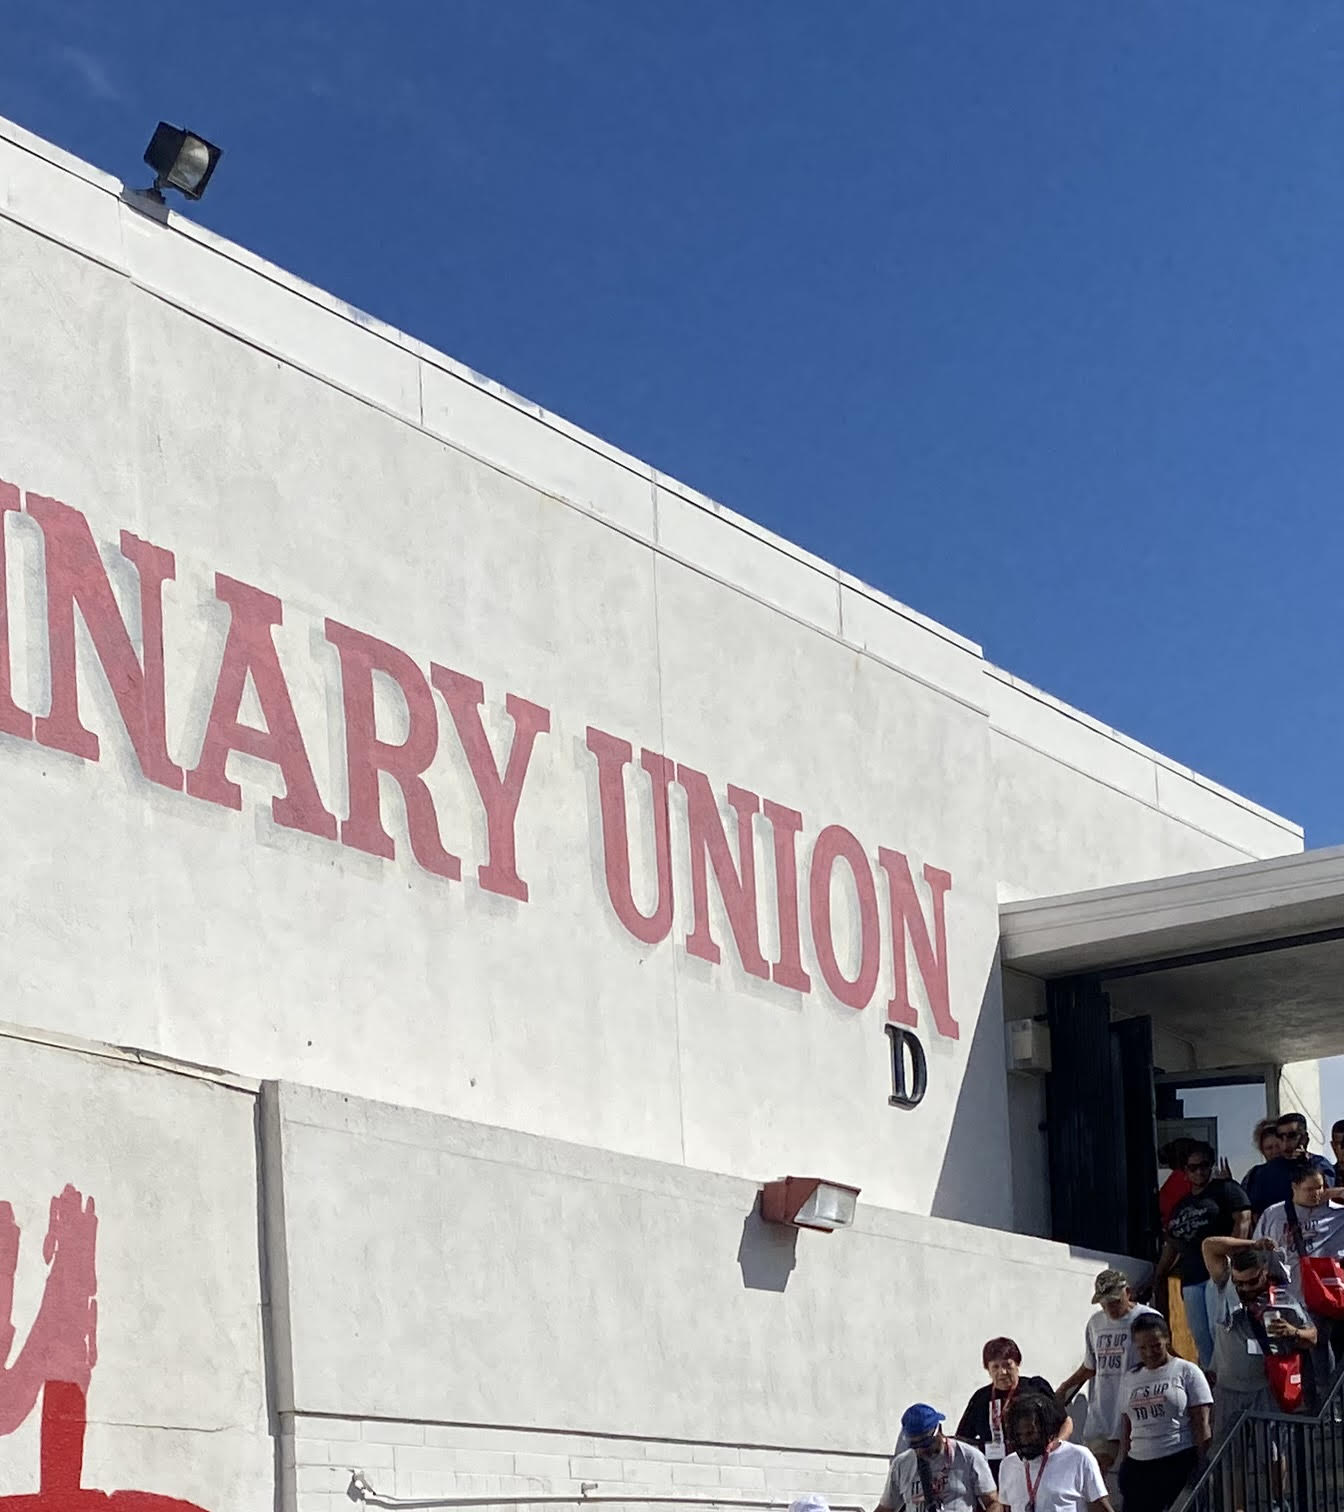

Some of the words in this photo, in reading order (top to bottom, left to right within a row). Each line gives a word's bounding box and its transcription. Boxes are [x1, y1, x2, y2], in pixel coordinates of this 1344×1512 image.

[586, 726, 960, 1040] UNION
[884, 1024, 928, 1110] D
[1114, 1333, 1127, 1346] UP
[1109, 1355, 1121, 1369] US
[1153, 1383, 1169, 1395] UP
[1151, 1404, 1166, 1418] US
